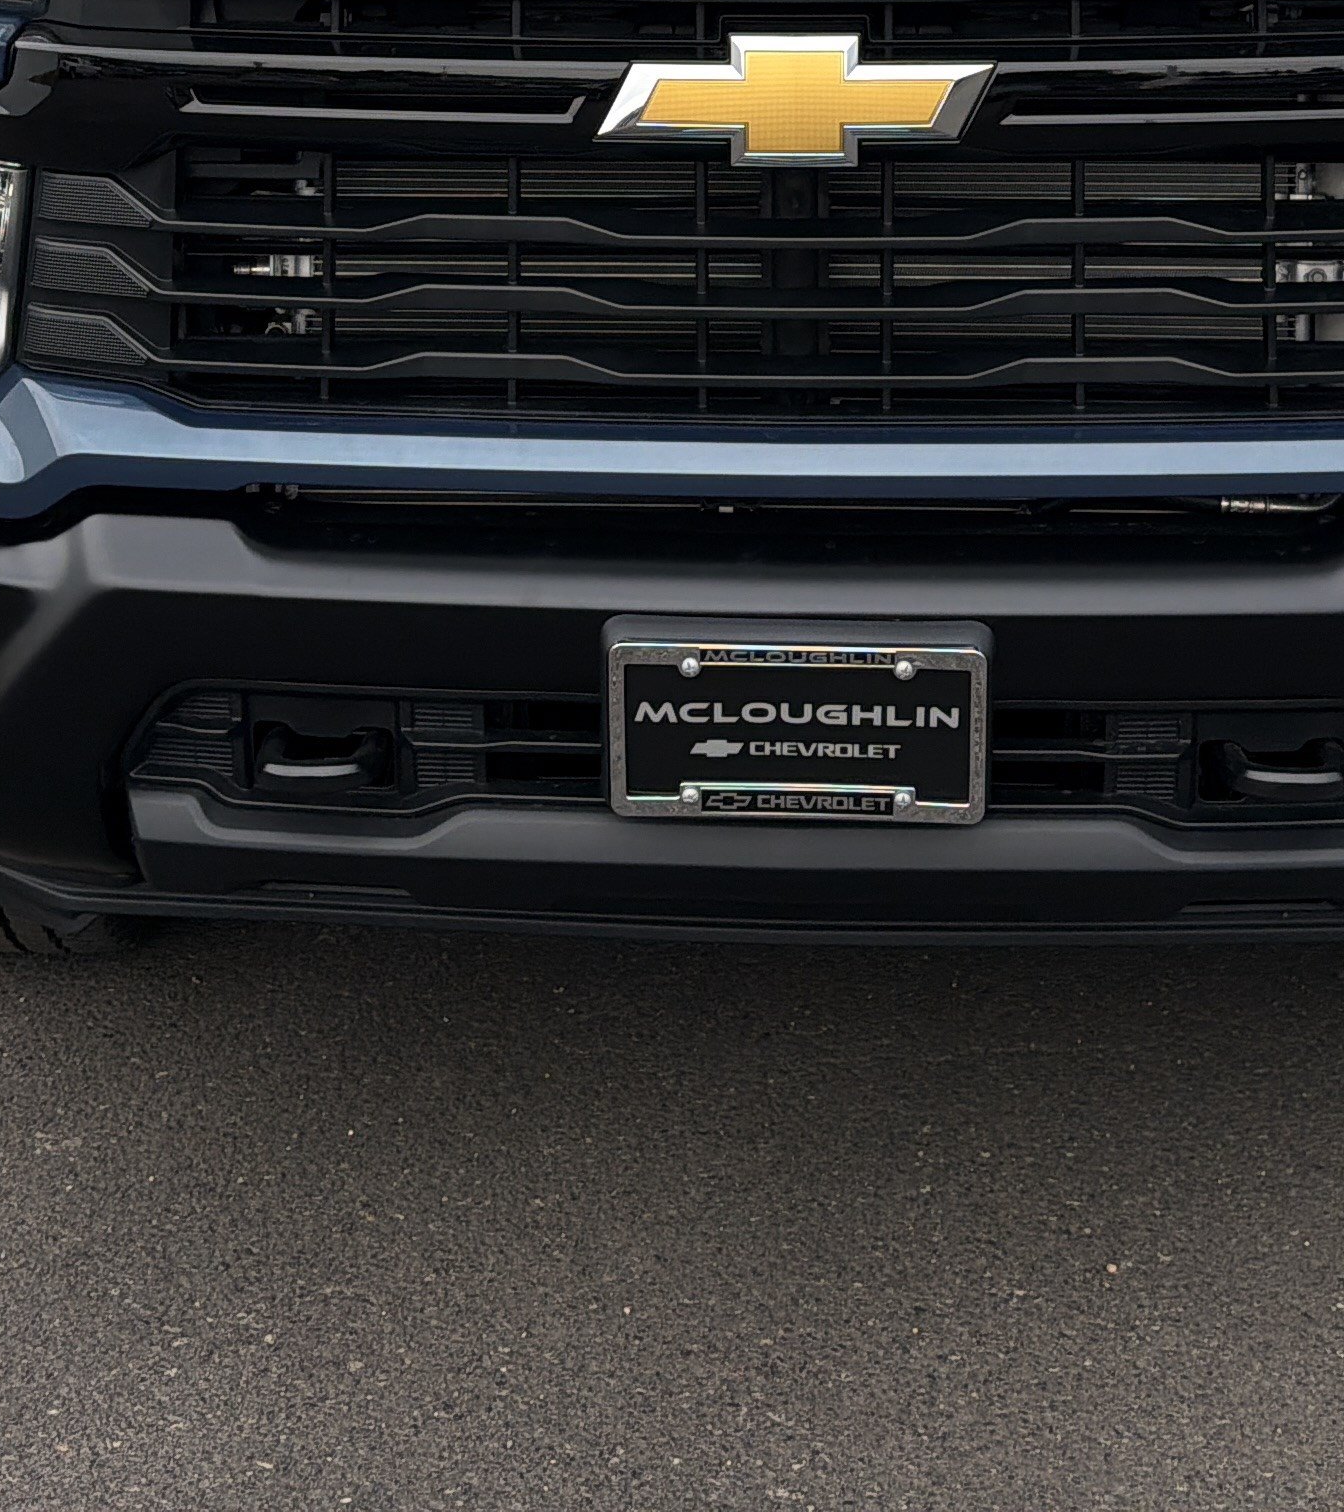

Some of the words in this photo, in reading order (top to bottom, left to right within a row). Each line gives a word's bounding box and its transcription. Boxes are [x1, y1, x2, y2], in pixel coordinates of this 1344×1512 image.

[705, 650, 893, 665] MCLOUGHLIN
[634, 701, 959, 728] MCLOUGHLIN
[749, 741, 901, 759] CHEVROLET
[757, 794, 890, 812] CHEVROLET
